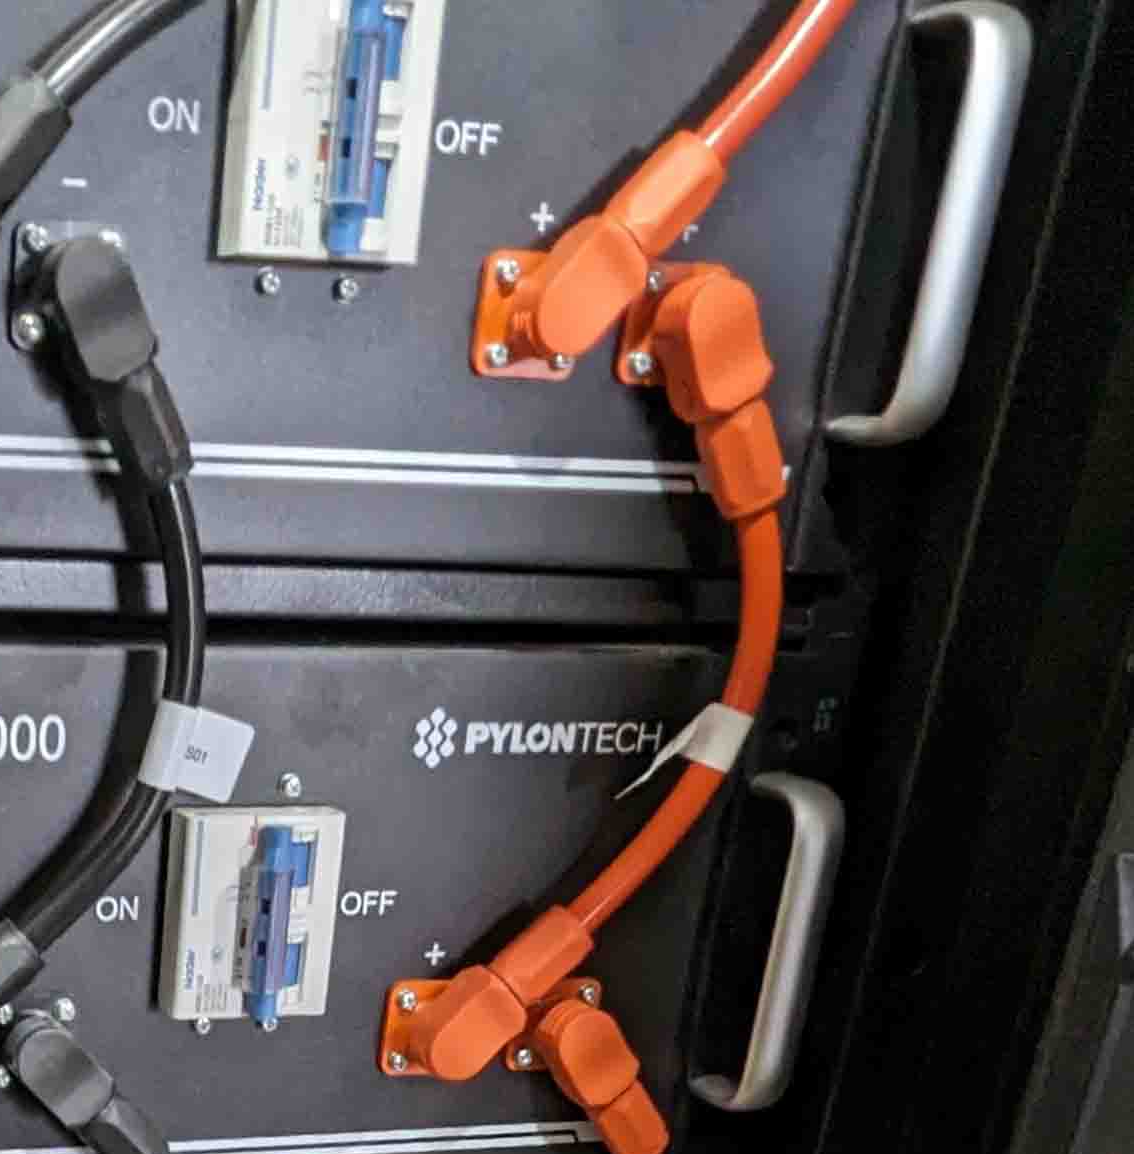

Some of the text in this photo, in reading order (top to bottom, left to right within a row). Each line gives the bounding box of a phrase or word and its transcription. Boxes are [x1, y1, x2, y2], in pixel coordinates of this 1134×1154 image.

[148, 97, 201, 134] ON
[435, 119, 503, 157] OFF
[464, 720, 664, 756] PYLONTECH
[95, 896, 140, 922] ON
[340, 890, 398, 914] OFF
